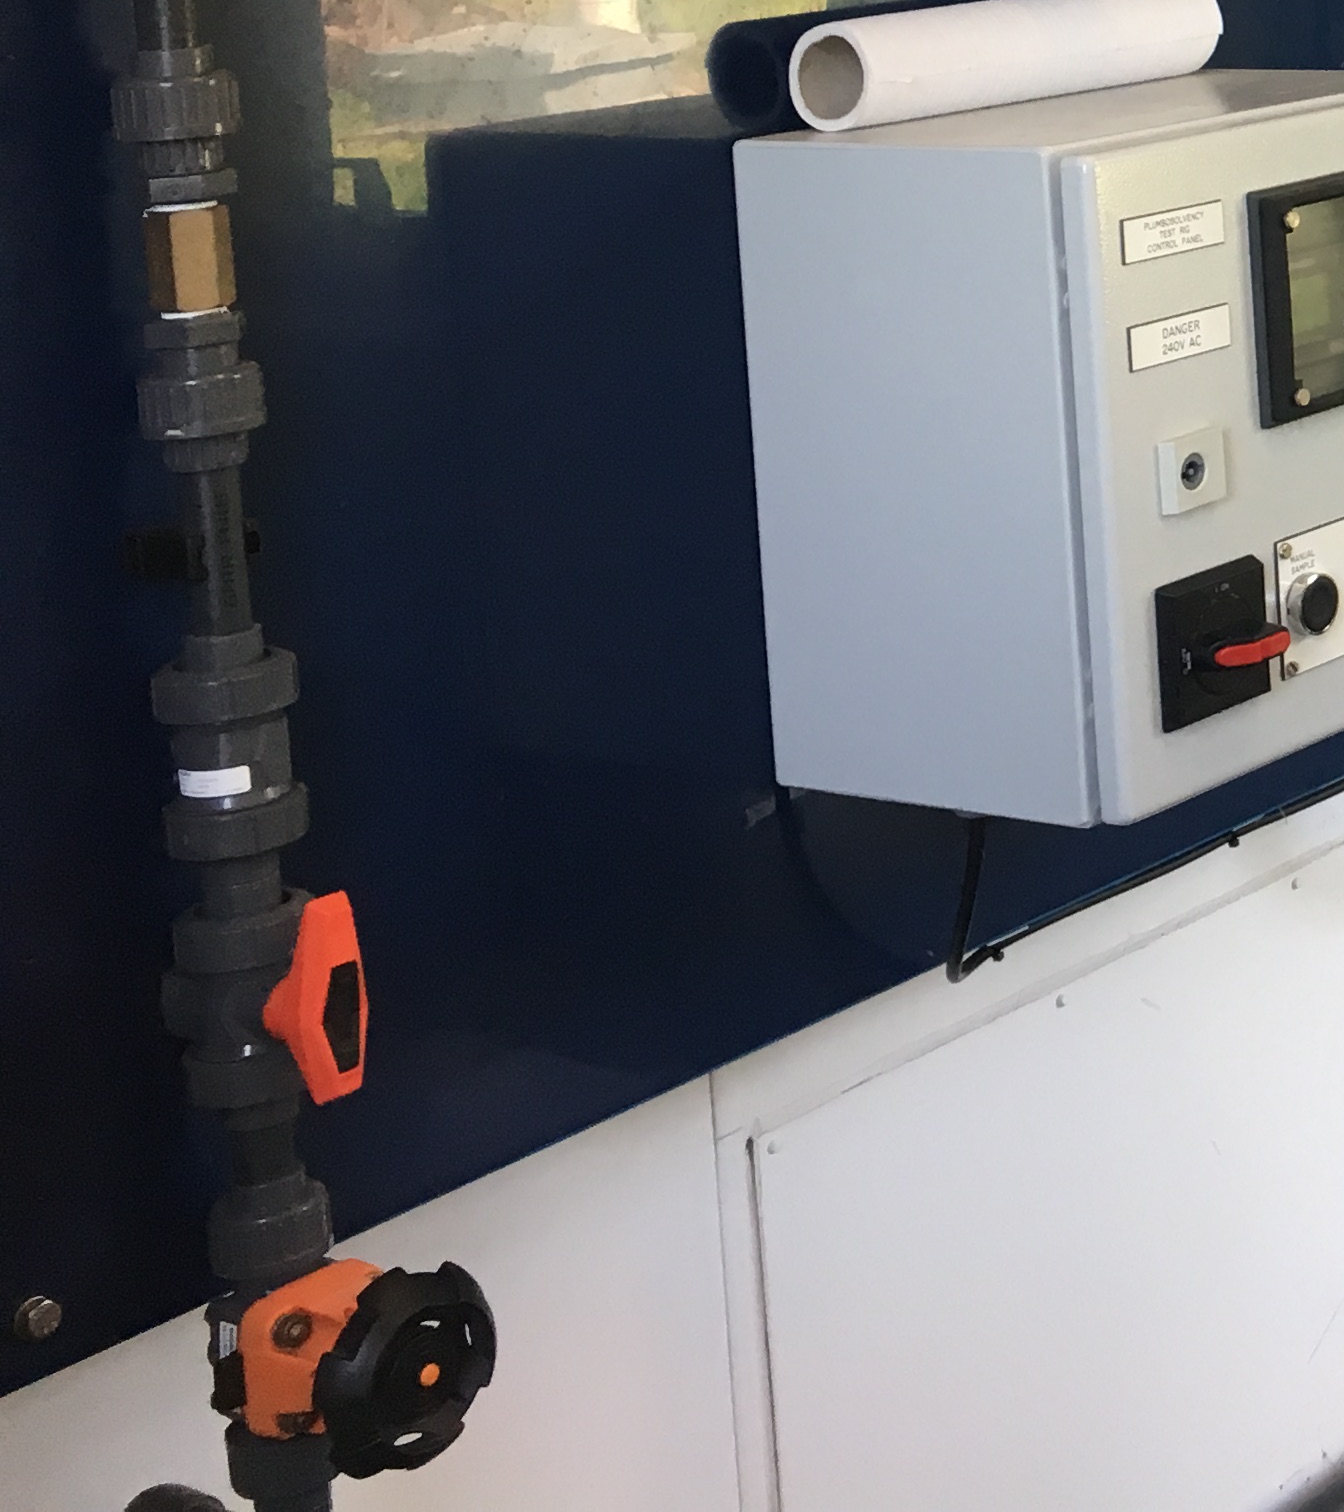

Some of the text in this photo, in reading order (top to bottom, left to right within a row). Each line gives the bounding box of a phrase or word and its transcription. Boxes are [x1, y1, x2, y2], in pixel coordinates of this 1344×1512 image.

[1159, 228, 1176, 239] TEST
[1147, 234, 1203, 253] CONTROL PANEL
[1162, 320, 1201, 339] DANGER
[1162, 335, 1201, 355] 240V AC
[1291, 560, 1315, 574] SAMPLE
